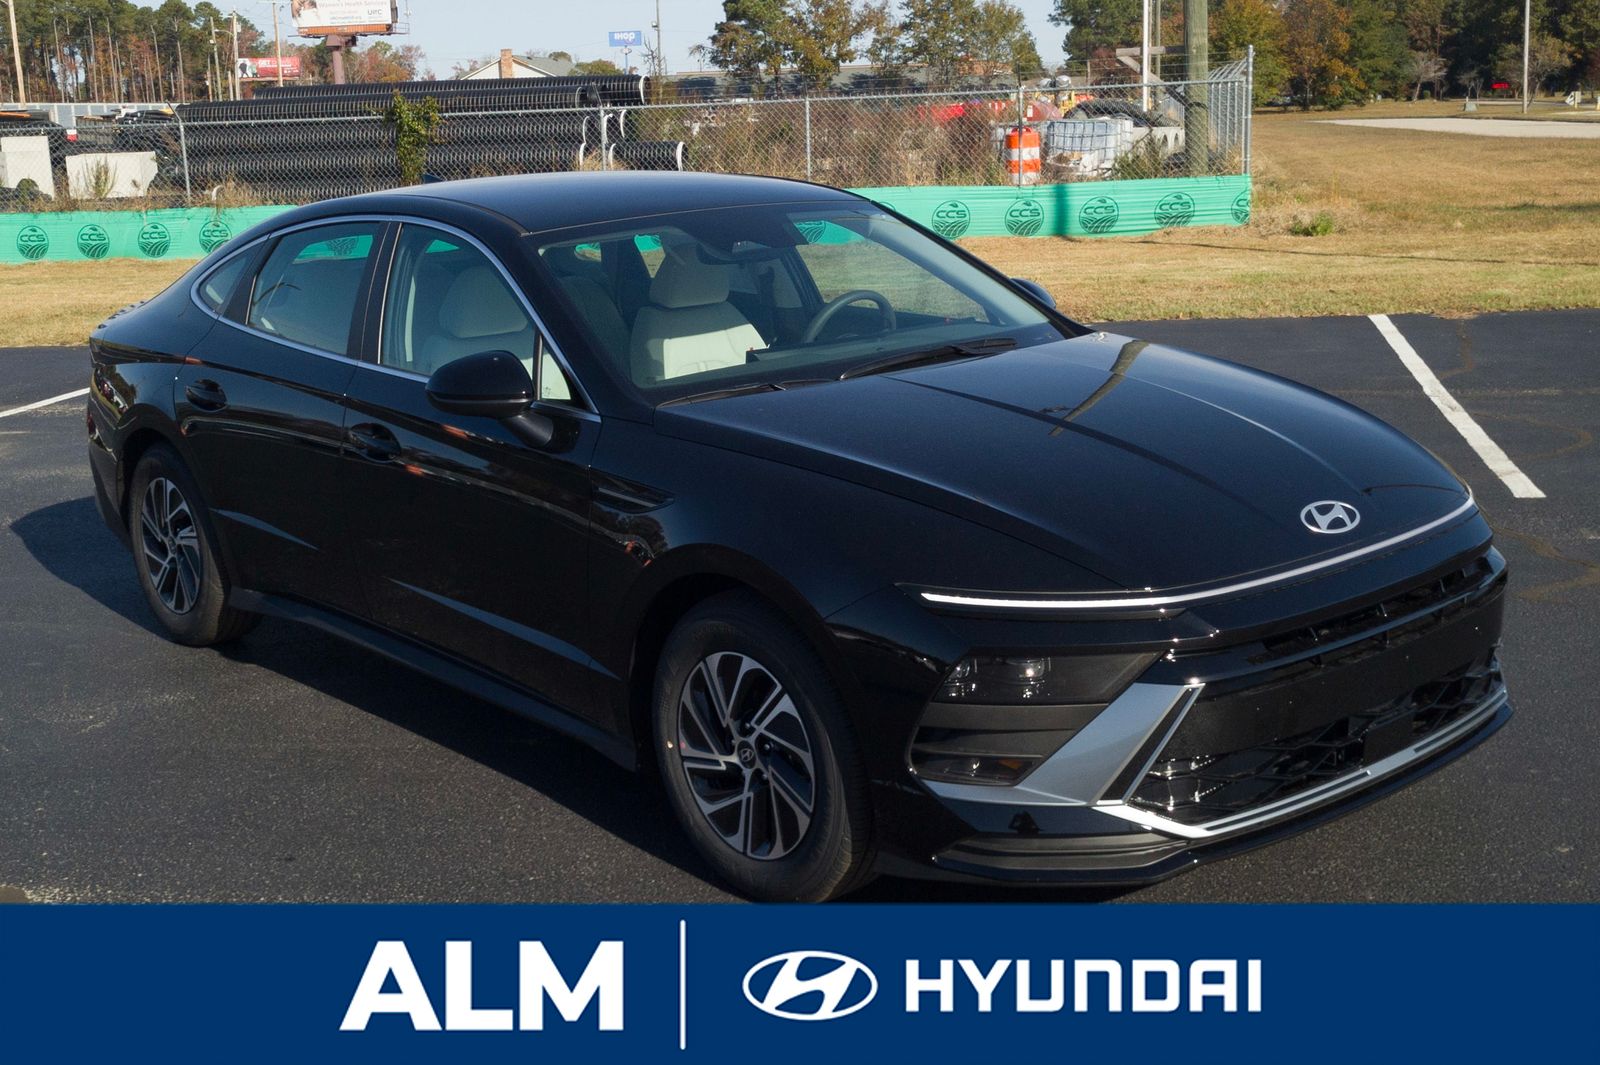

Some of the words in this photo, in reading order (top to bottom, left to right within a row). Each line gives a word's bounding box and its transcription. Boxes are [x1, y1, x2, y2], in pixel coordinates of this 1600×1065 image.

[1083, 205, 1116, 216] CCS
[1159, 201, 1192, 212] CCS
[936, 209, 967, 219] CCS
[1009, 208, 1041, 218] CCS
[80, 233, 107, 242] CCS
[141, 231, 168, 240] CCS
[202, 229, 229, 238] CCS
[20, 234, 46, 243] CCS
